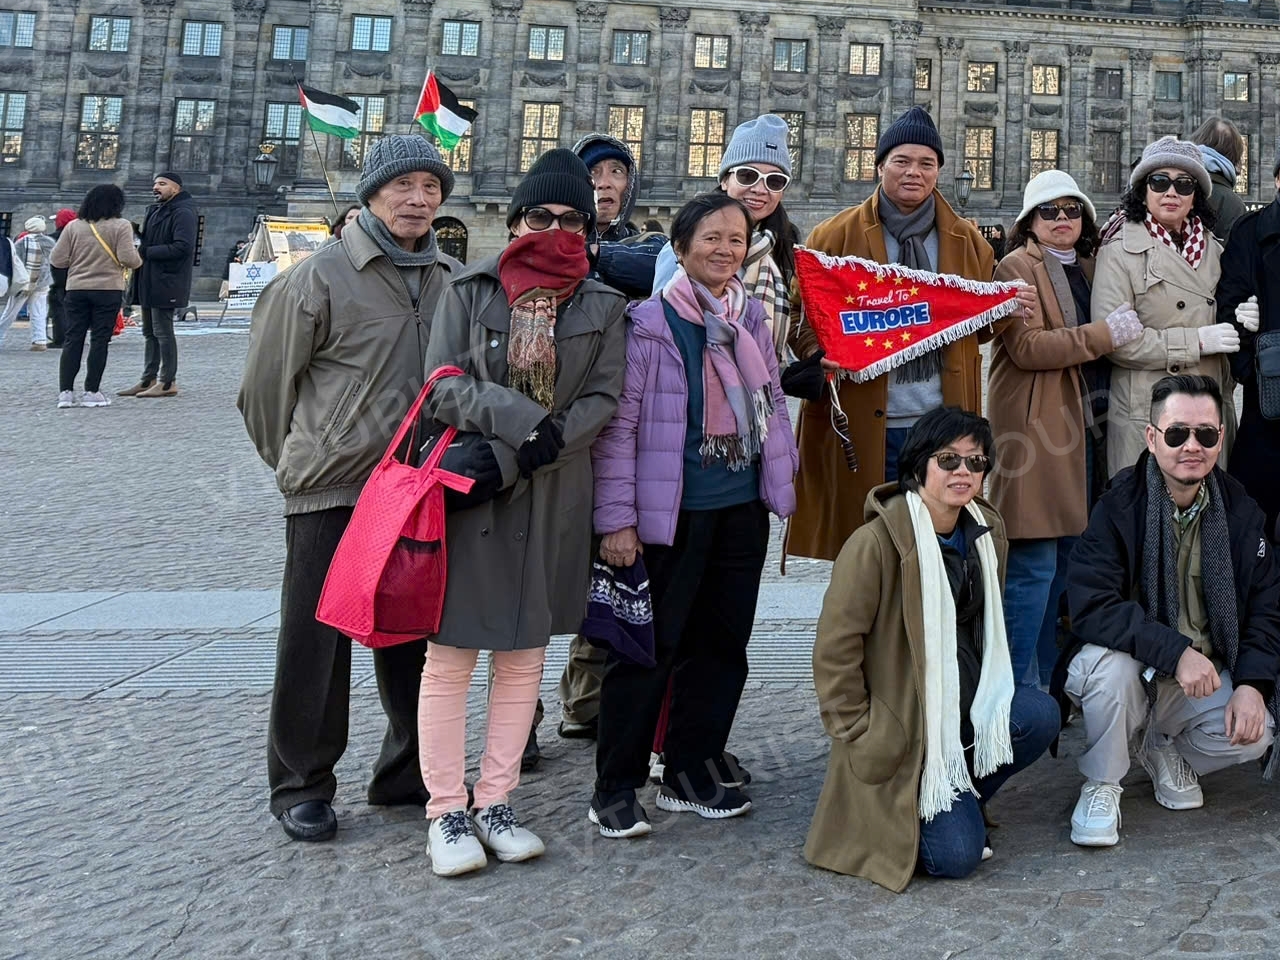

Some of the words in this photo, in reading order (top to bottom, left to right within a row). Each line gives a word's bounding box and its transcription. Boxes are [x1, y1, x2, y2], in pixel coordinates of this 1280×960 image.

[857, 289, 894, 307] Travel
[895, 288, 911, 301] To
[840, 302, 931, 334] EUROPE
